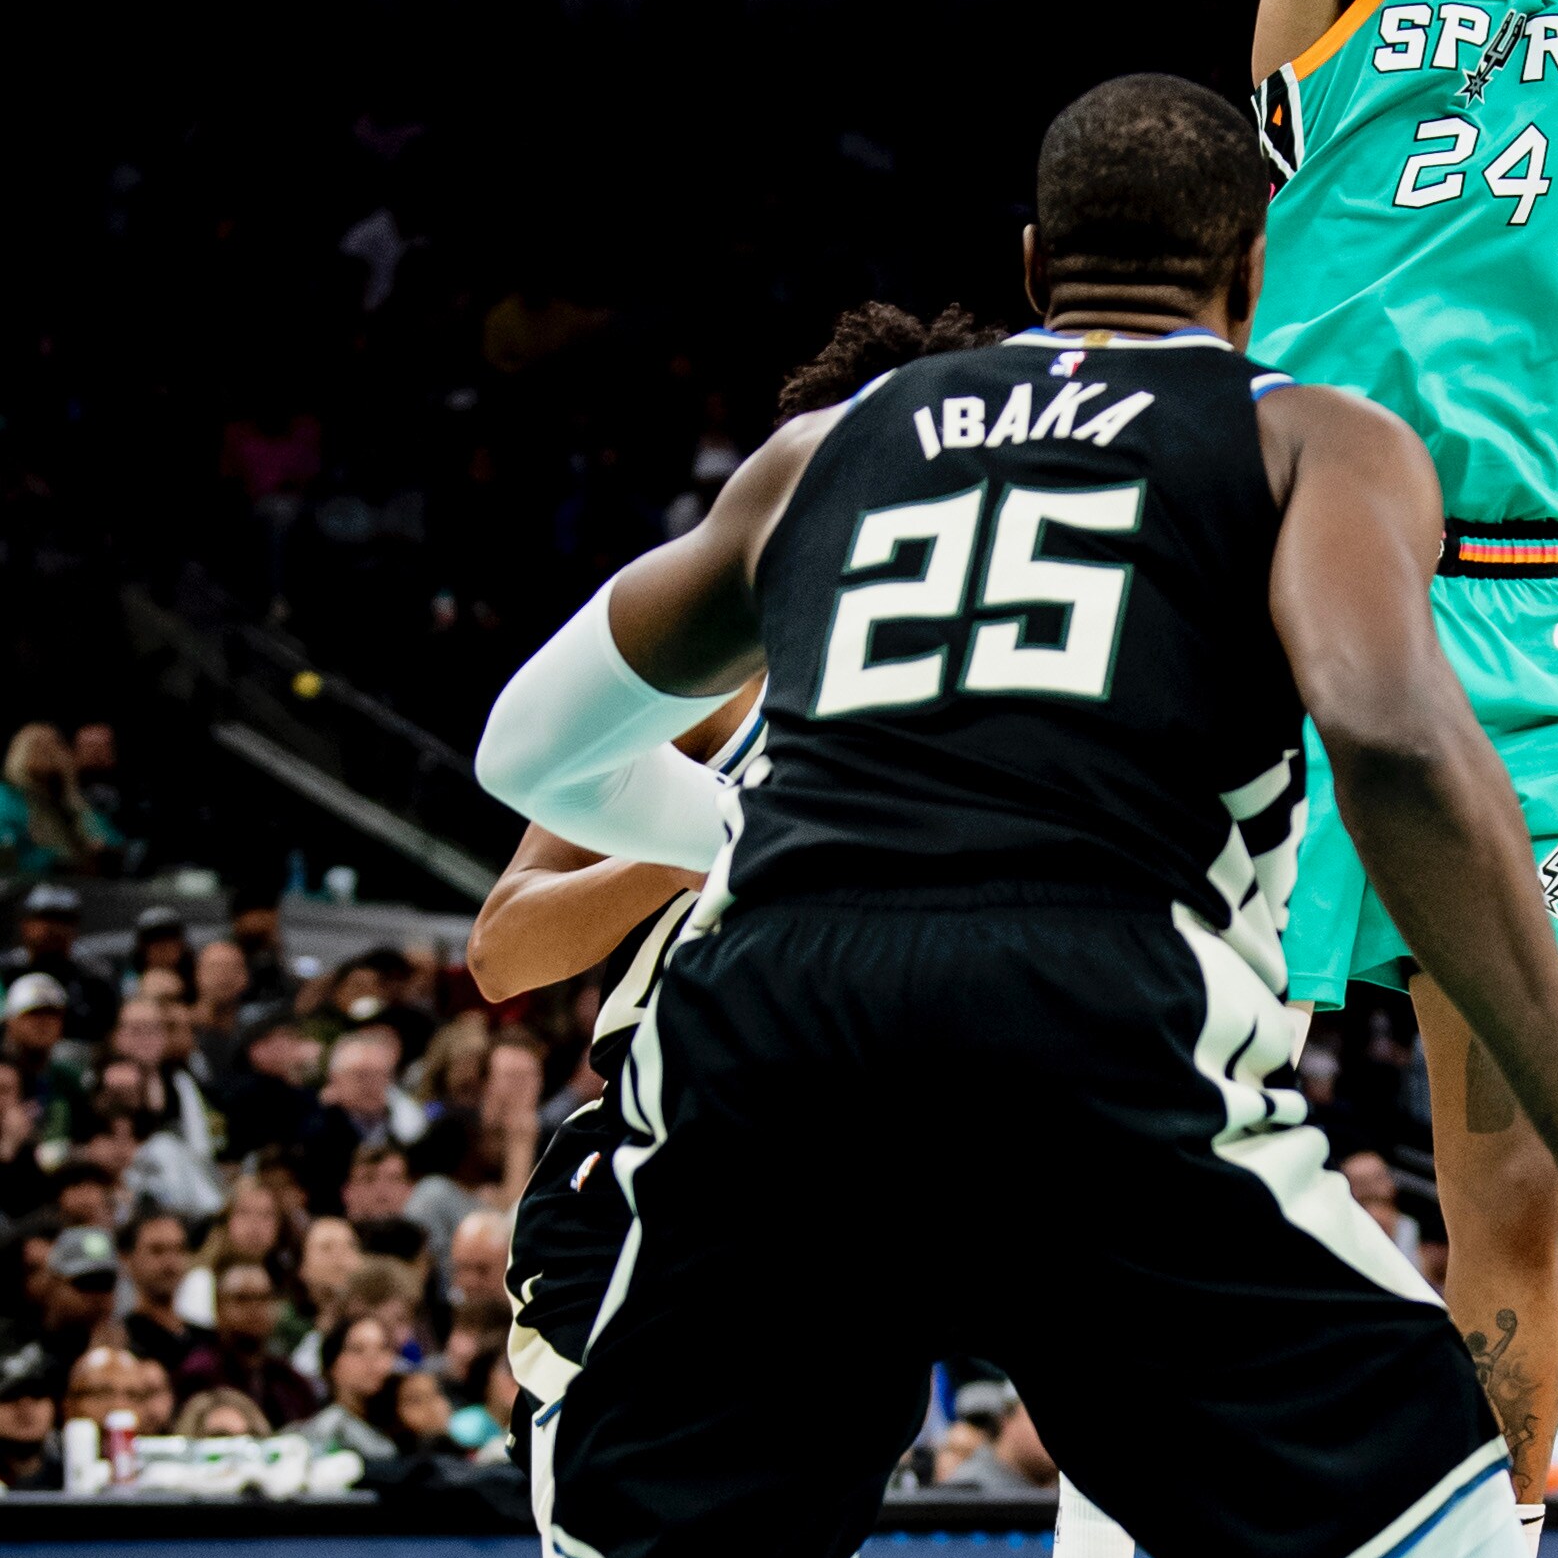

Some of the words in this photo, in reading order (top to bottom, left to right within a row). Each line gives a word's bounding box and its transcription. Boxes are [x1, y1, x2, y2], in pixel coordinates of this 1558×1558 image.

[1393, 116, 1552, 227] 24
[914, 382, 1155, 461] IBAKA
[807, 477, 1147, 721] 25
